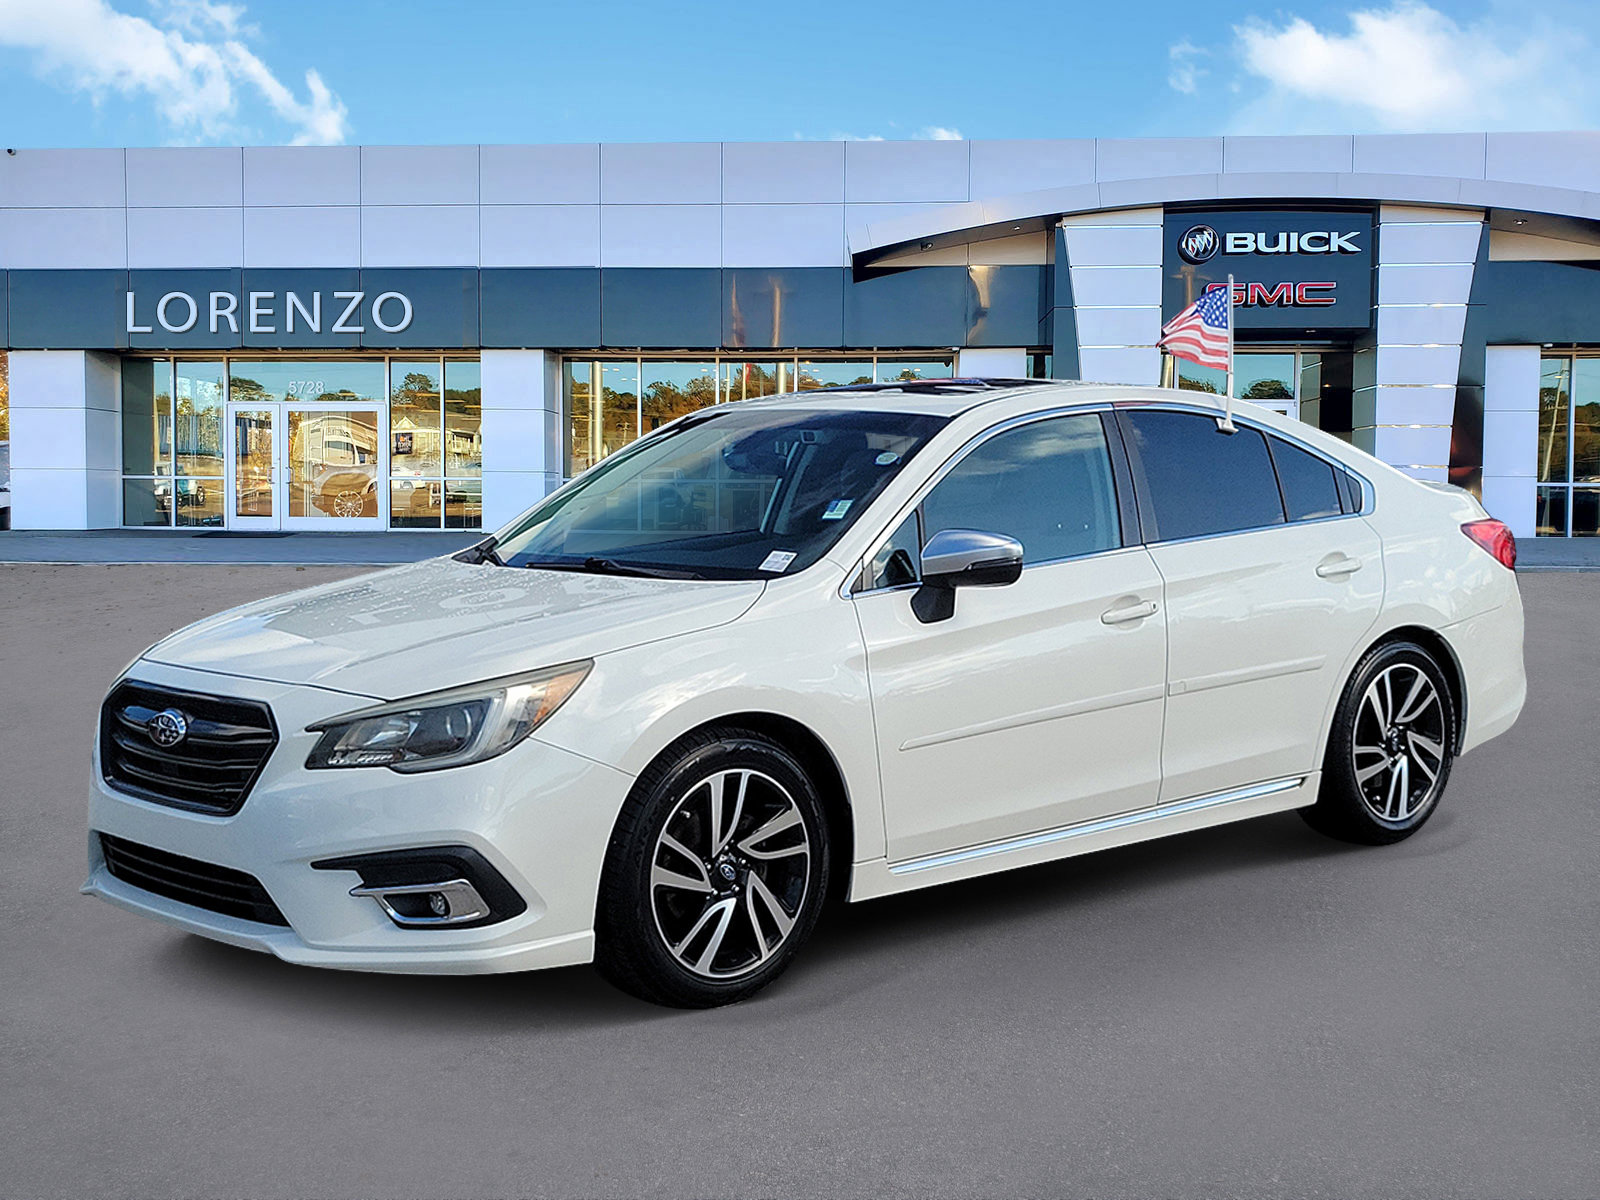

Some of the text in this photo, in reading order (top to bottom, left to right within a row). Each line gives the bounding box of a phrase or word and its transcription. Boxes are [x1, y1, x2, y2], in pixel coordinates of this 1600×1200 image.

[1225, 231, 1361, 253] BUICK
[126, 291, 414, 334] LORENZO
[288, 380, 326, 395] 5728
